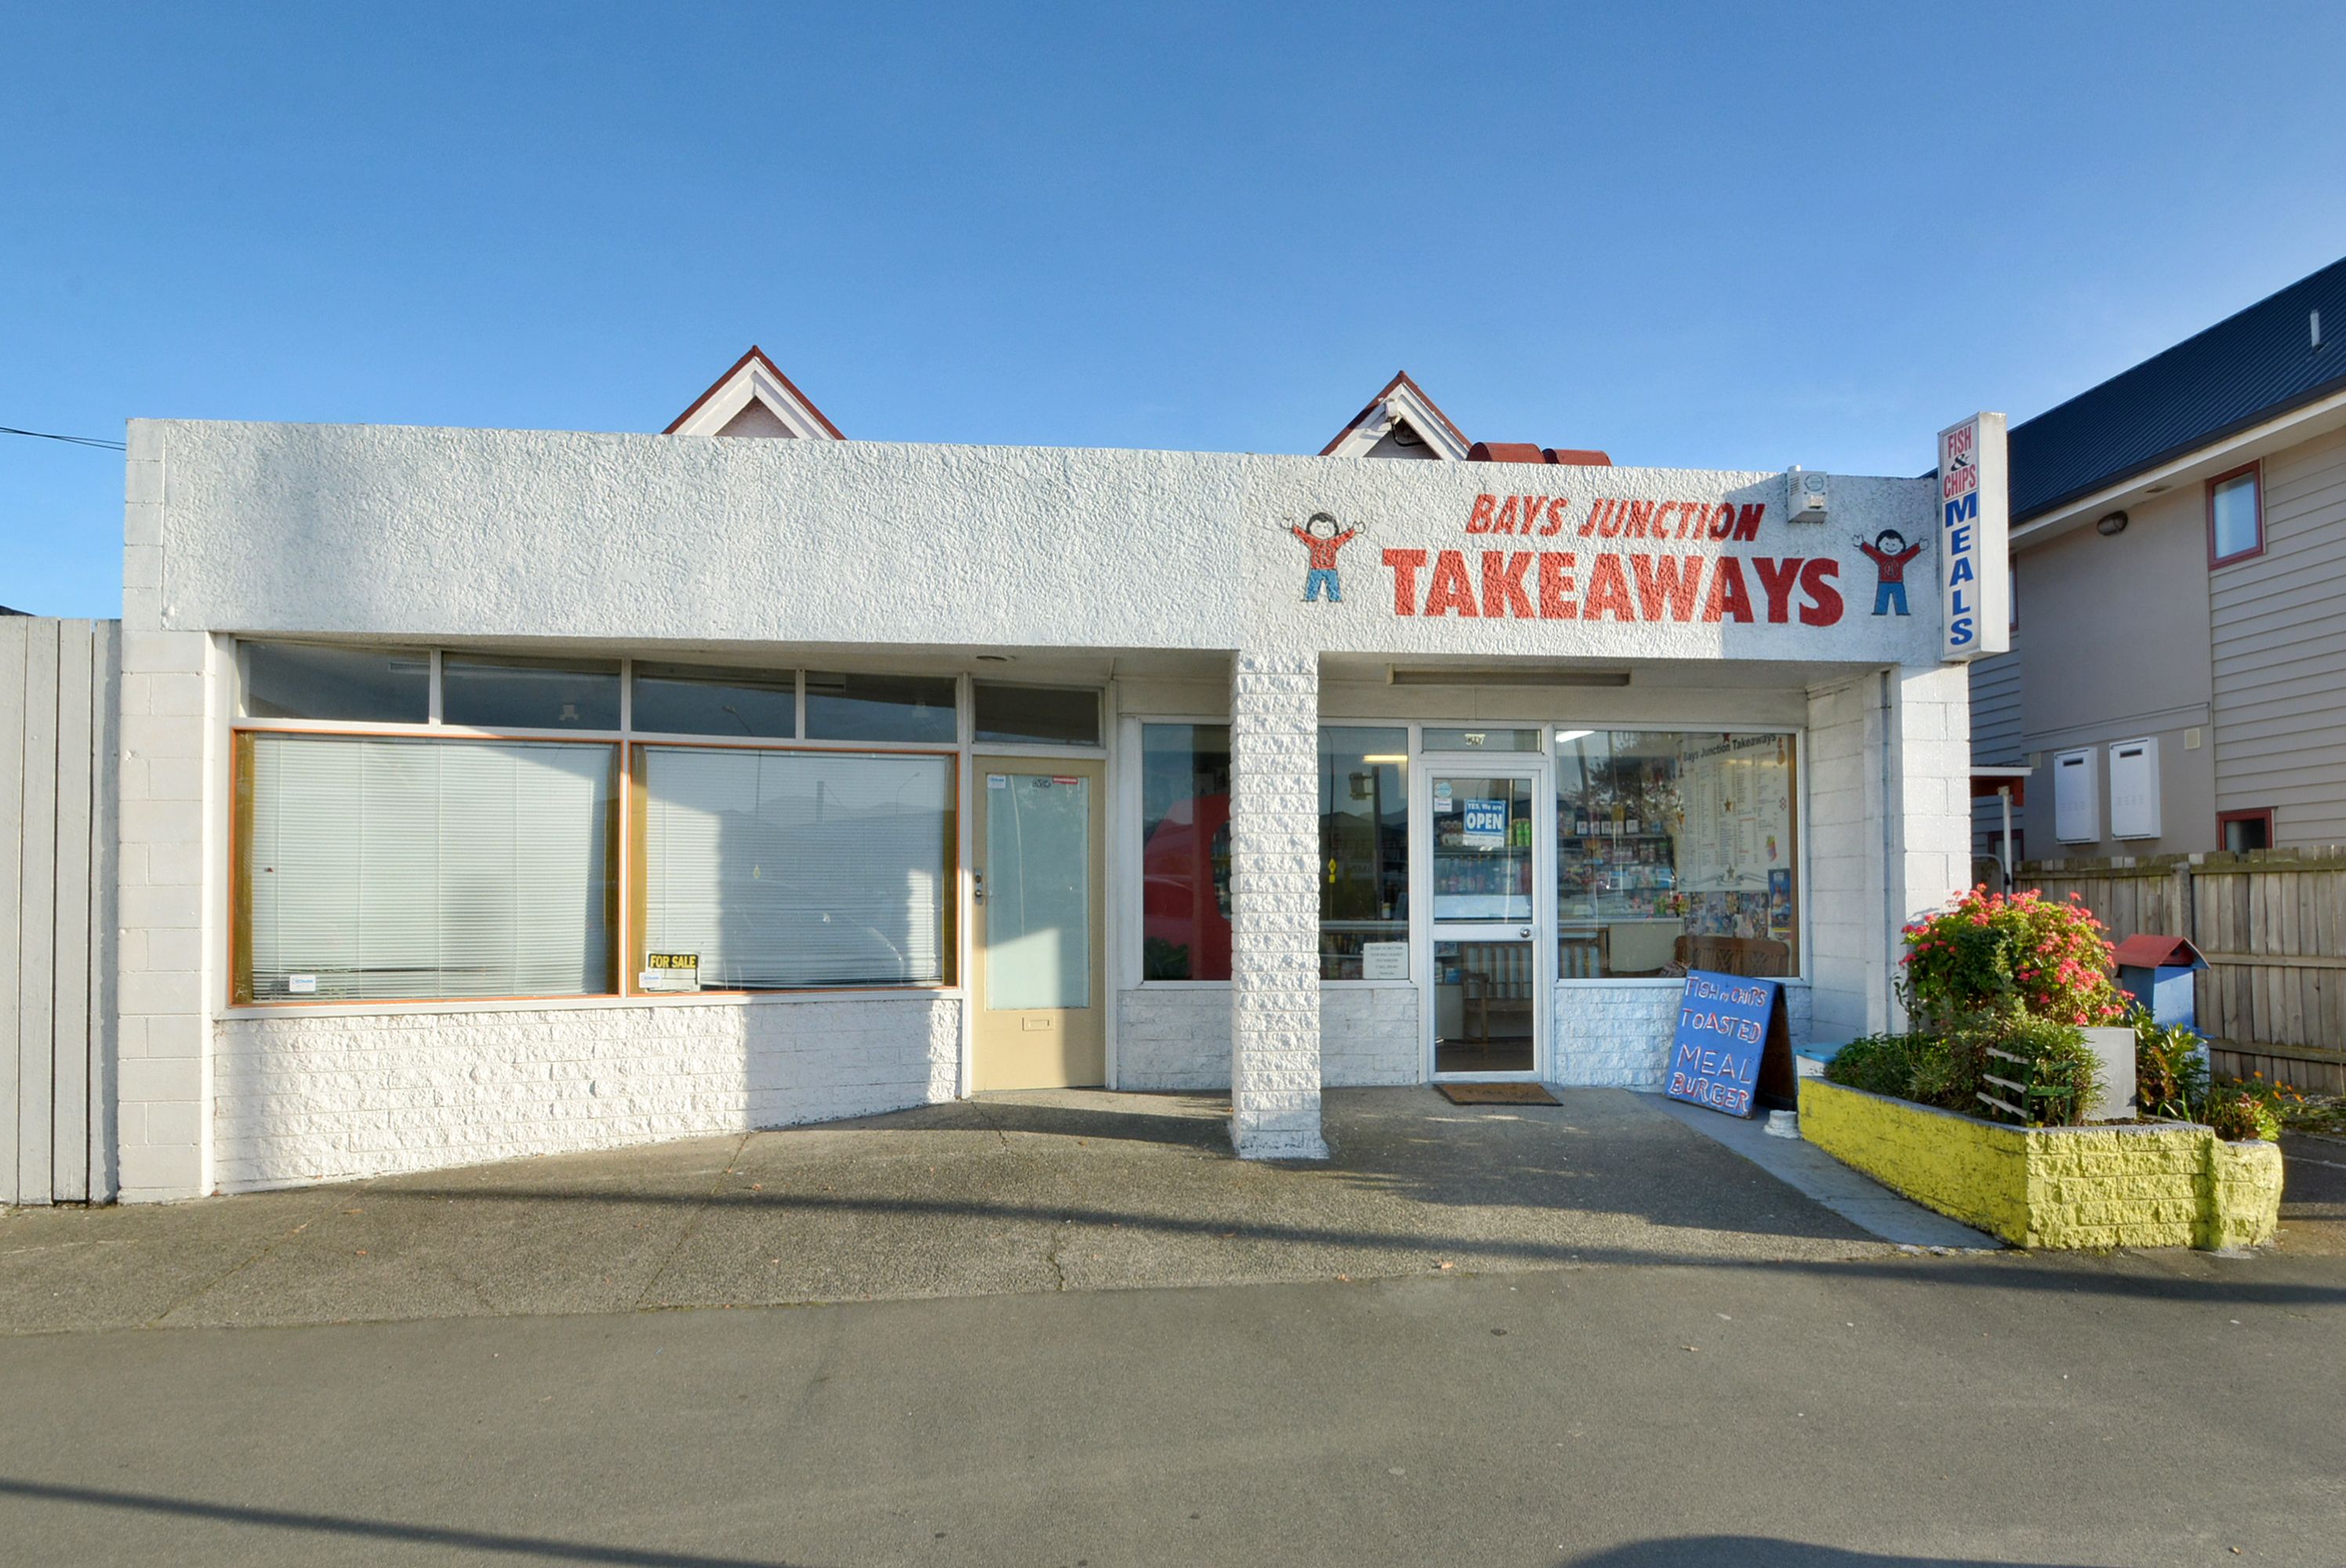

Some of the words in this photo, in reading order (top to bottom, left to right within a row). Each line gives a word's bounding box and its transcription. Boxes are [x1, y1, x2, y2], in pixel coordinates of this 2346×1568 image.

[1948, 426, 1972, 459] FISH
[1950, 453, 1970, 471] &
[1944, 464, 1976, 499] CHIPS
[1465, 493, 1569, 537] BAYS
[1578, 497, 1766, 543] JUNCTION
[1945, 492, 1977, 646] MEALS
[1382, 548, 1845, 627] TAKEAWAYS
[1466, 812, 1503, 830] OPEN
[650, 955, 670, 968] FOR
[671, 955, 697, 968] SALE
[1681, 1008, 1763, 1044] TOASTED
[1676, 1044, 1752, 1084] MEAL
[1669, 1072, 1750, 1112] BURGER
